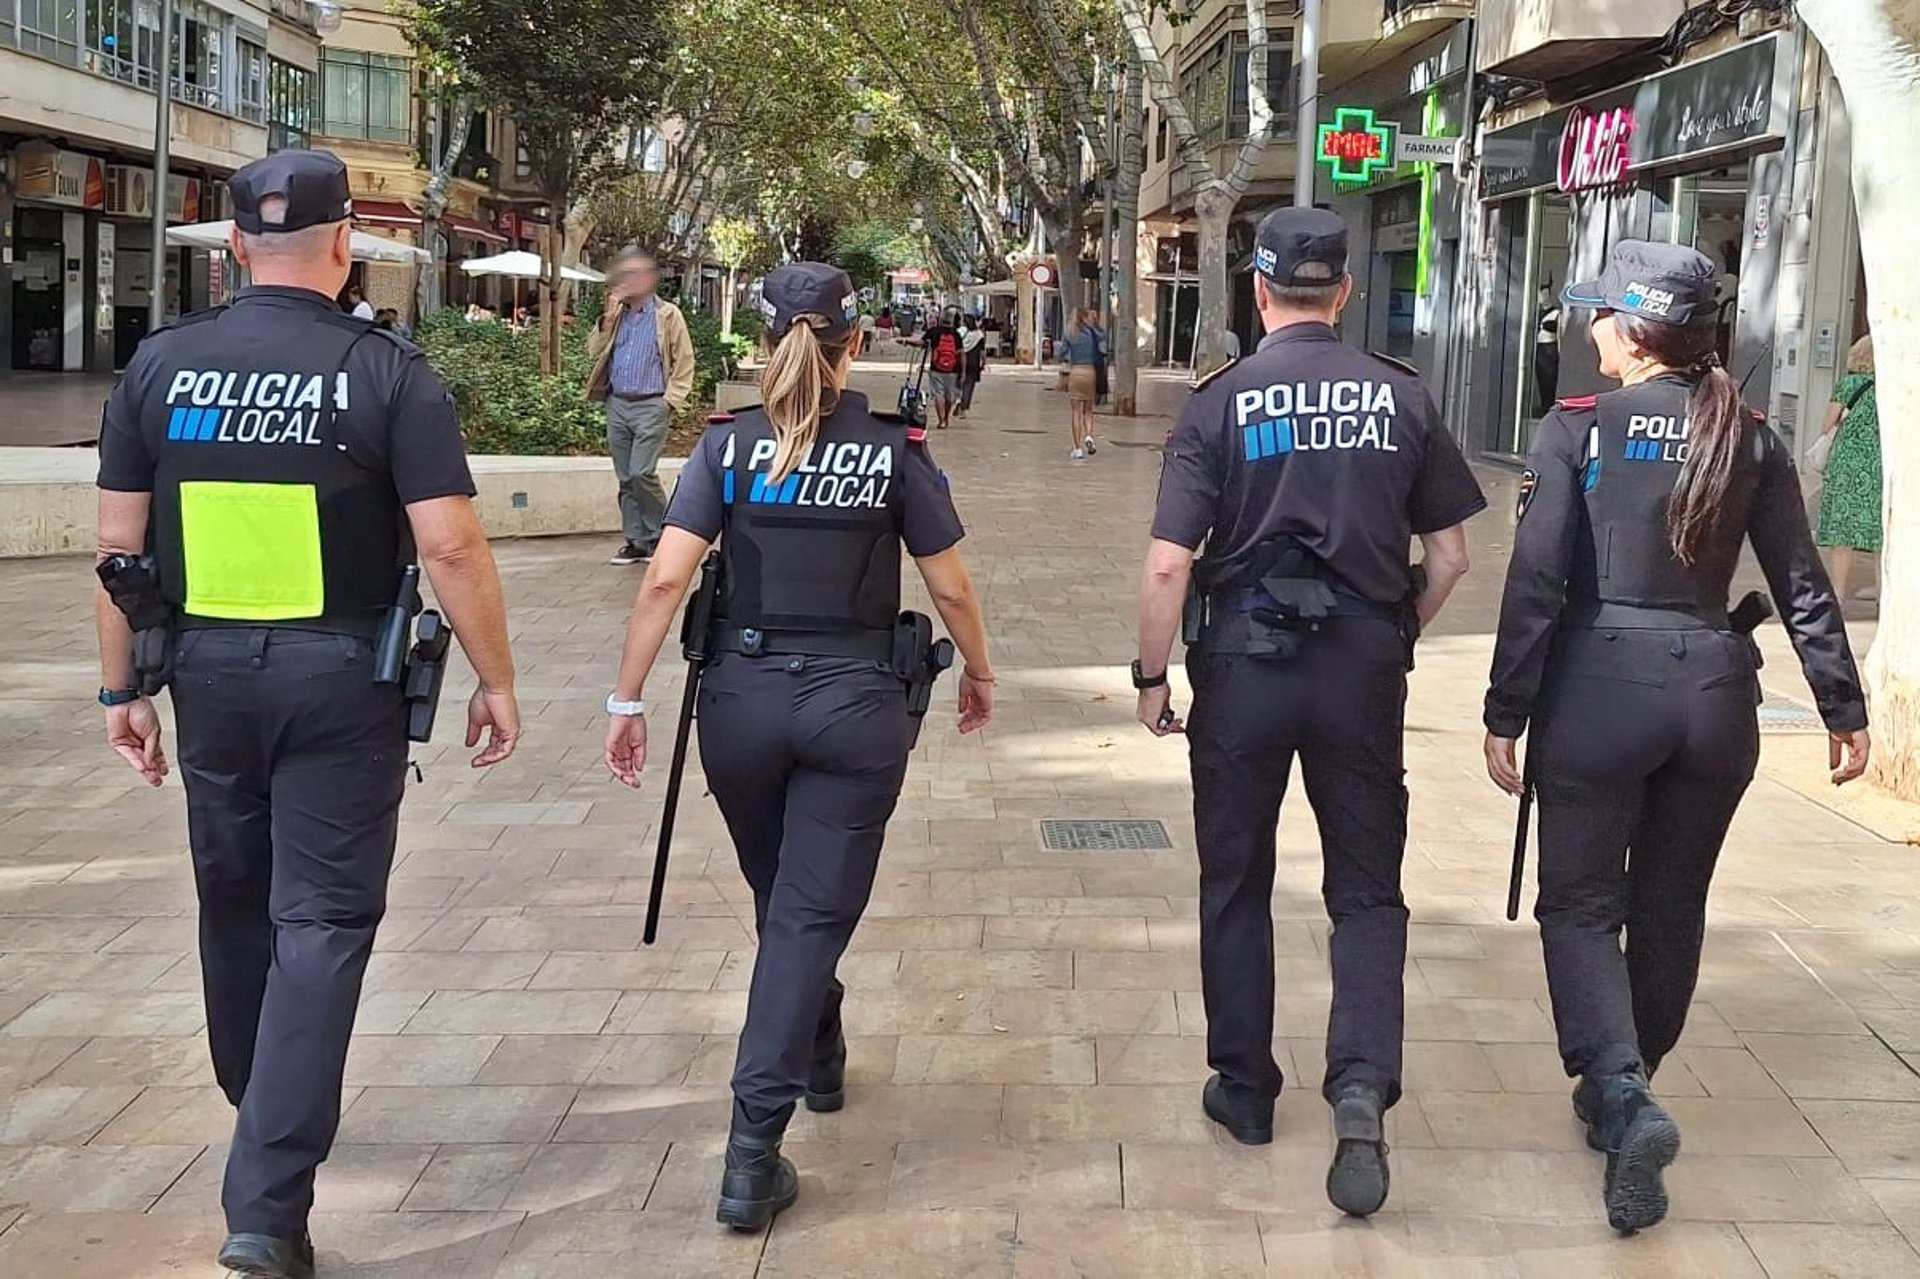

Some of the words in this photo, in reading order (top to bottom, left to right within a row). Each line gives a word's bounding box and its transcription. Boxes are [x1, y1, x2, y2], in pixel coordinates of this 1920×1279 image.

[1626, 281, 1674, 304] POLICIA
[166, 370, 323, 409] POLICIA
[1236, 381, 1396, 426] POLICIA
[217, 408, 322, 444] LOCAL
[1292, 415, 1398, 451] LOCAL
[1627, 415, 1690, 439] POLI
[748, 439, 893, 477] PLICIA
[797, 475, 890, 508] LOCAL
